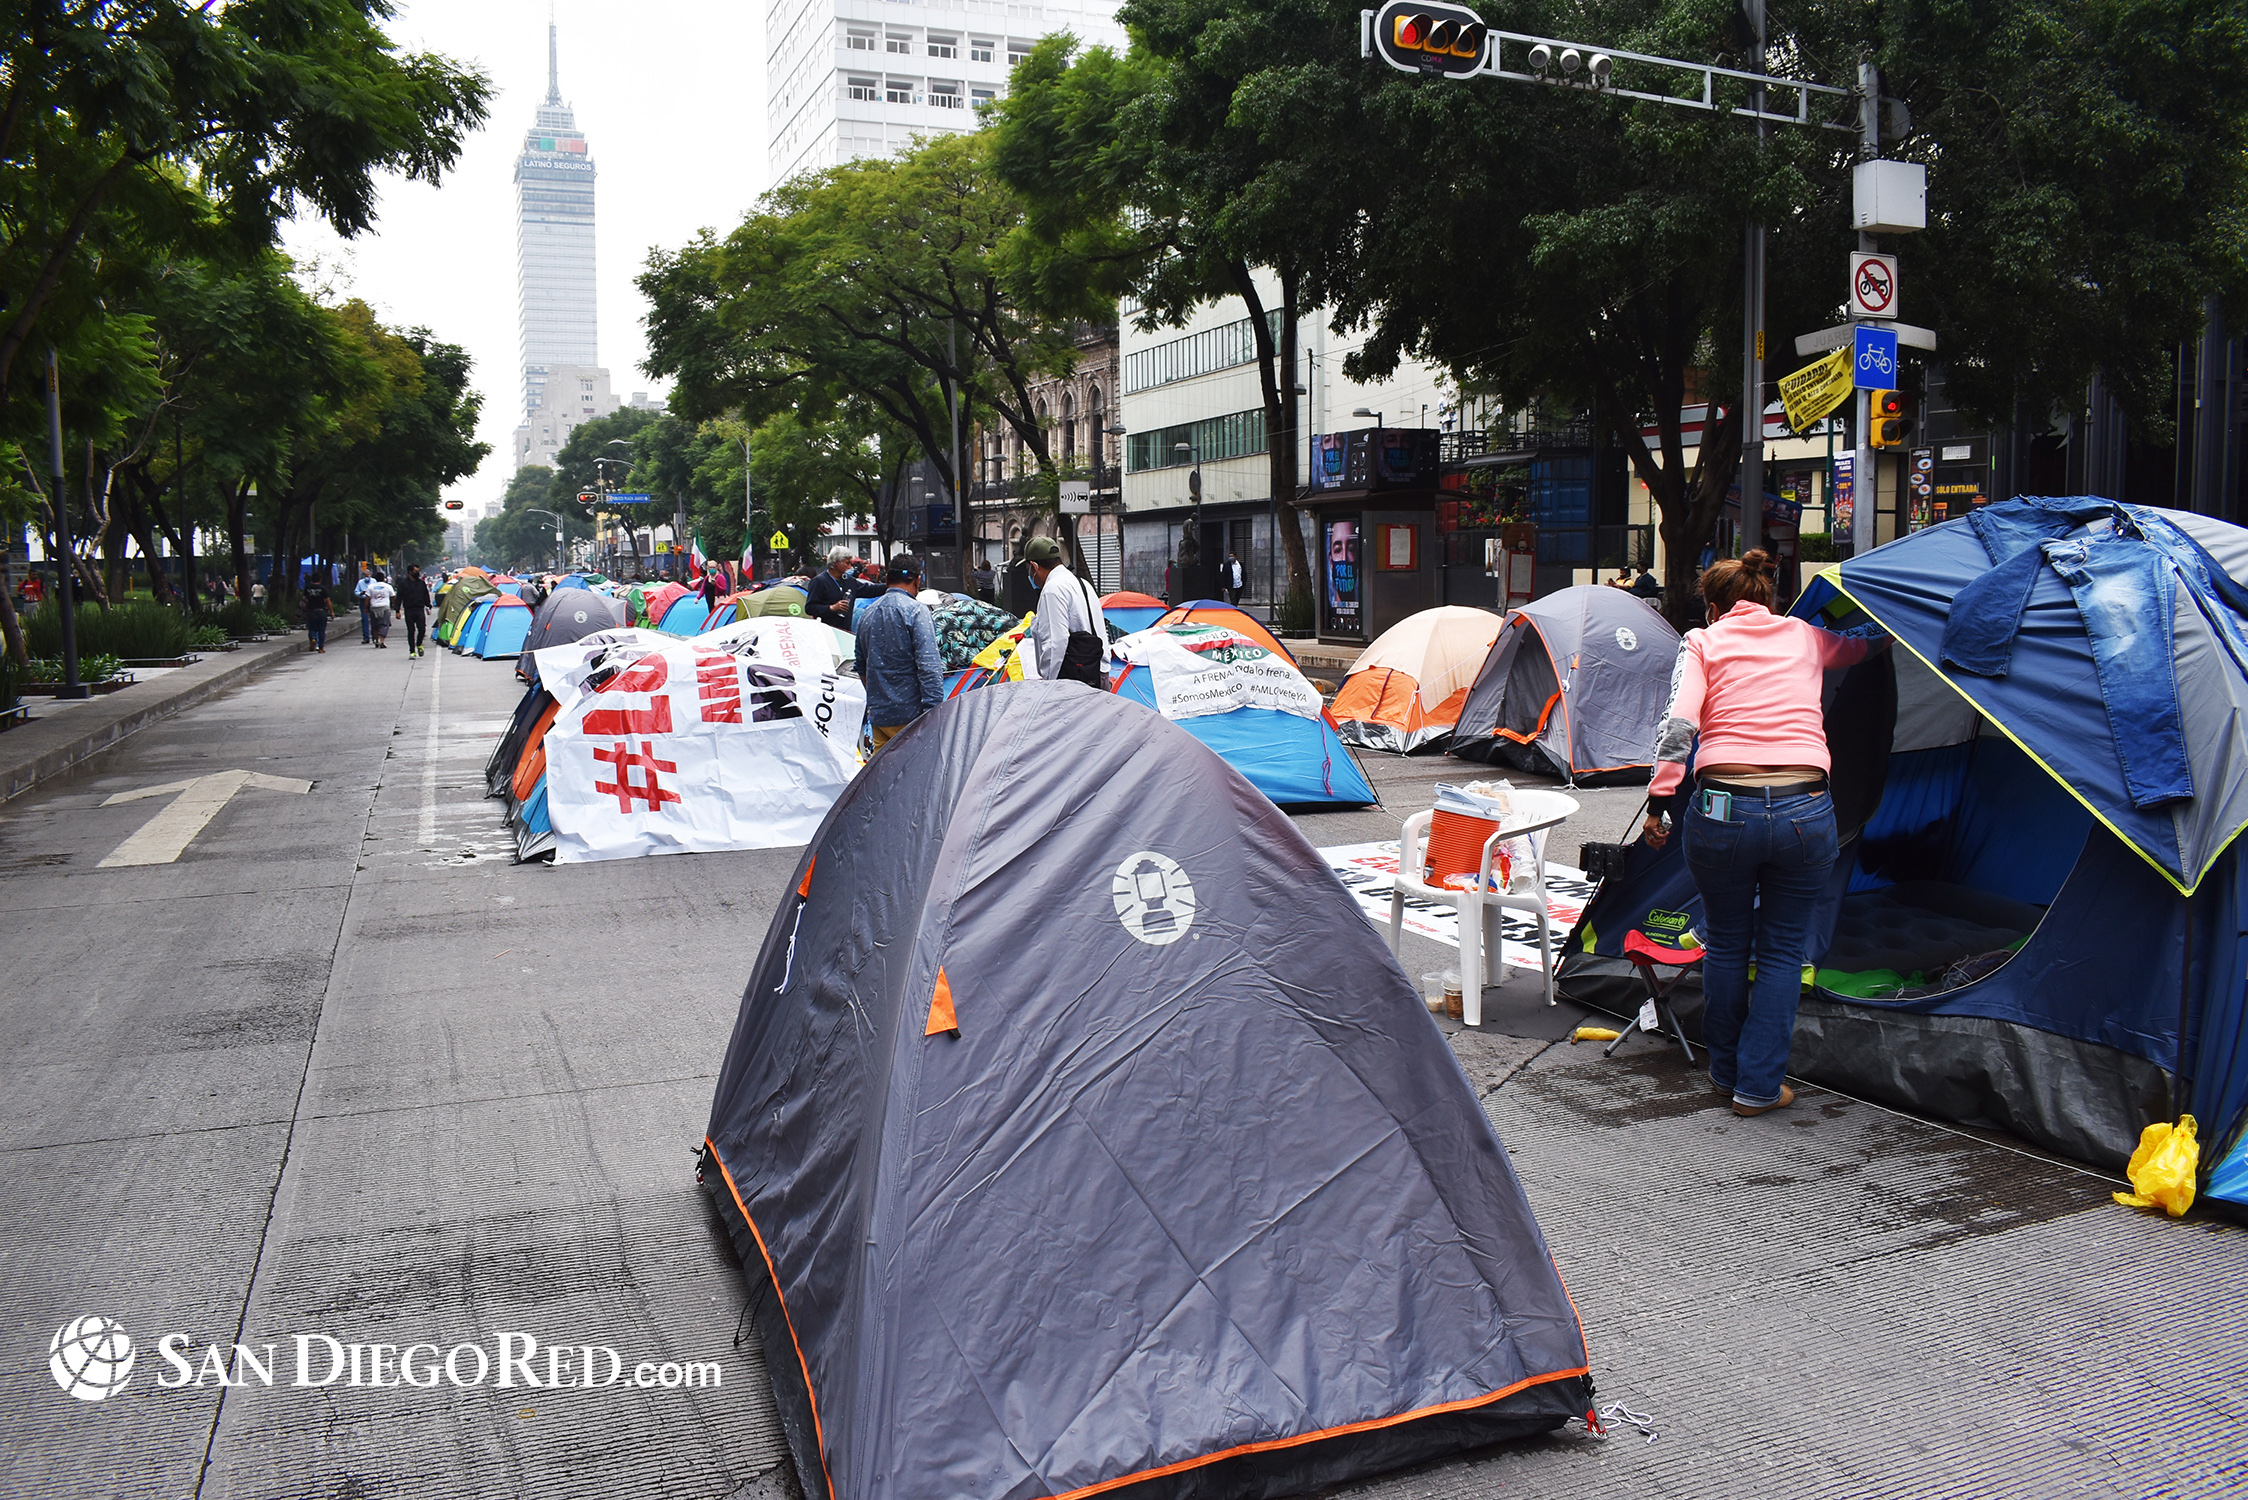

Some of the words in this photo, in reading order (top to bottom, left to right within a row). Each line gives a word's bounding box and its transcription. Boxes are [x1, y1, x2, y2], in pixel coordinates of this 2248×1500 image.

[1420, 54, 1442, 63] CDMX
[524, 160, 552, 169] LATINO
[553, 161, 592, 171] SEGUROS
[1951, 484, 1977, 494] ENTRADA
[1335, 564, 1347, 577] POR
[1347, 565, 1353, 577] EL
[1335, 578, 1355, 592] FUTURO
[1211, 647, 1262, 662] MÉXICO
[1193, 675, 1201, 684] A
[1265, 667, 1292, 680] frena.
[1171, 682, 1243, 704] #SomosMexico
